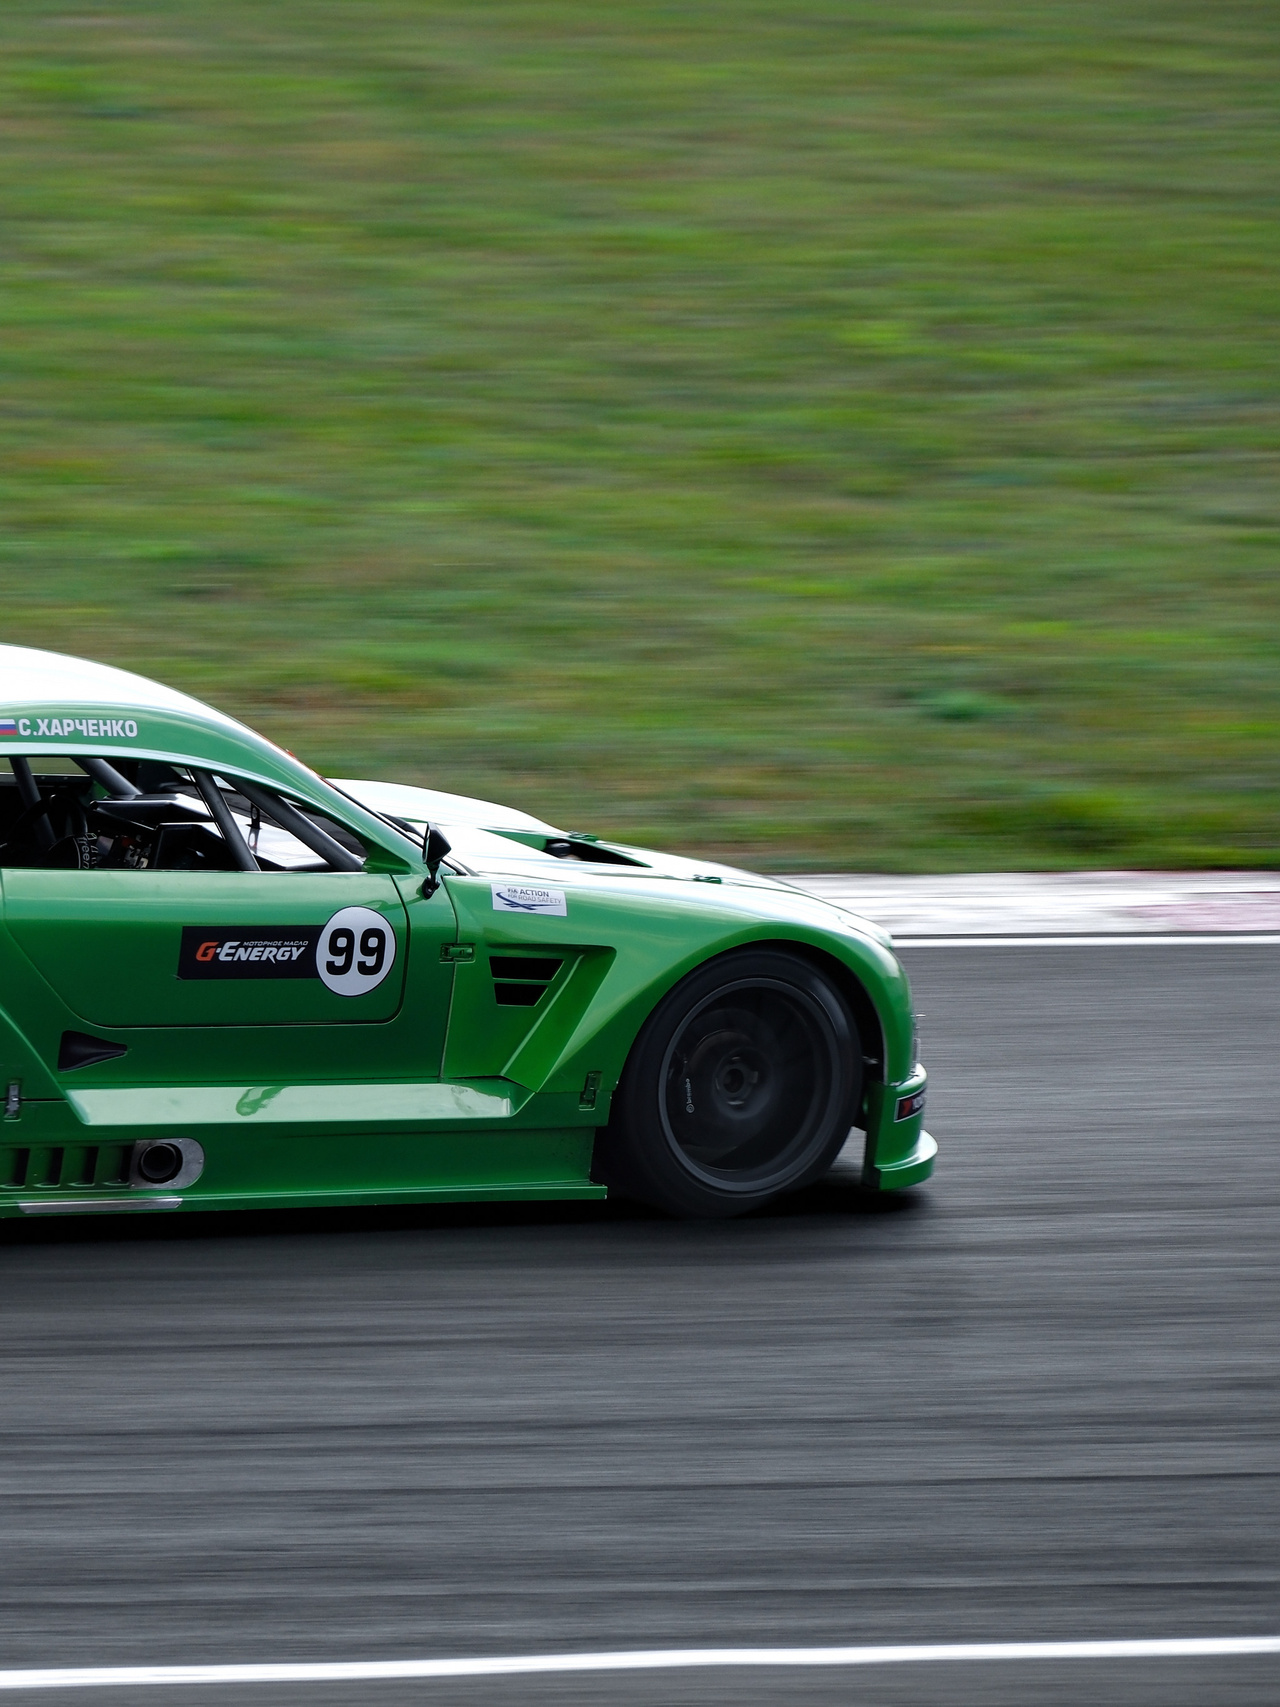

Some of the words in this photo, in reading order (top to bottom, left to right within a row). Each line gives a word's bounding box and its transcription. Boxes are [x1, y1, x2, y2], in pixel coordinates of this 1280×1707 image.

[18, 718, 138, 738] С.ХАРЧЕНКО
[519, 888, 549, 898] ACTION
[325, 927, 386, 976] 99
